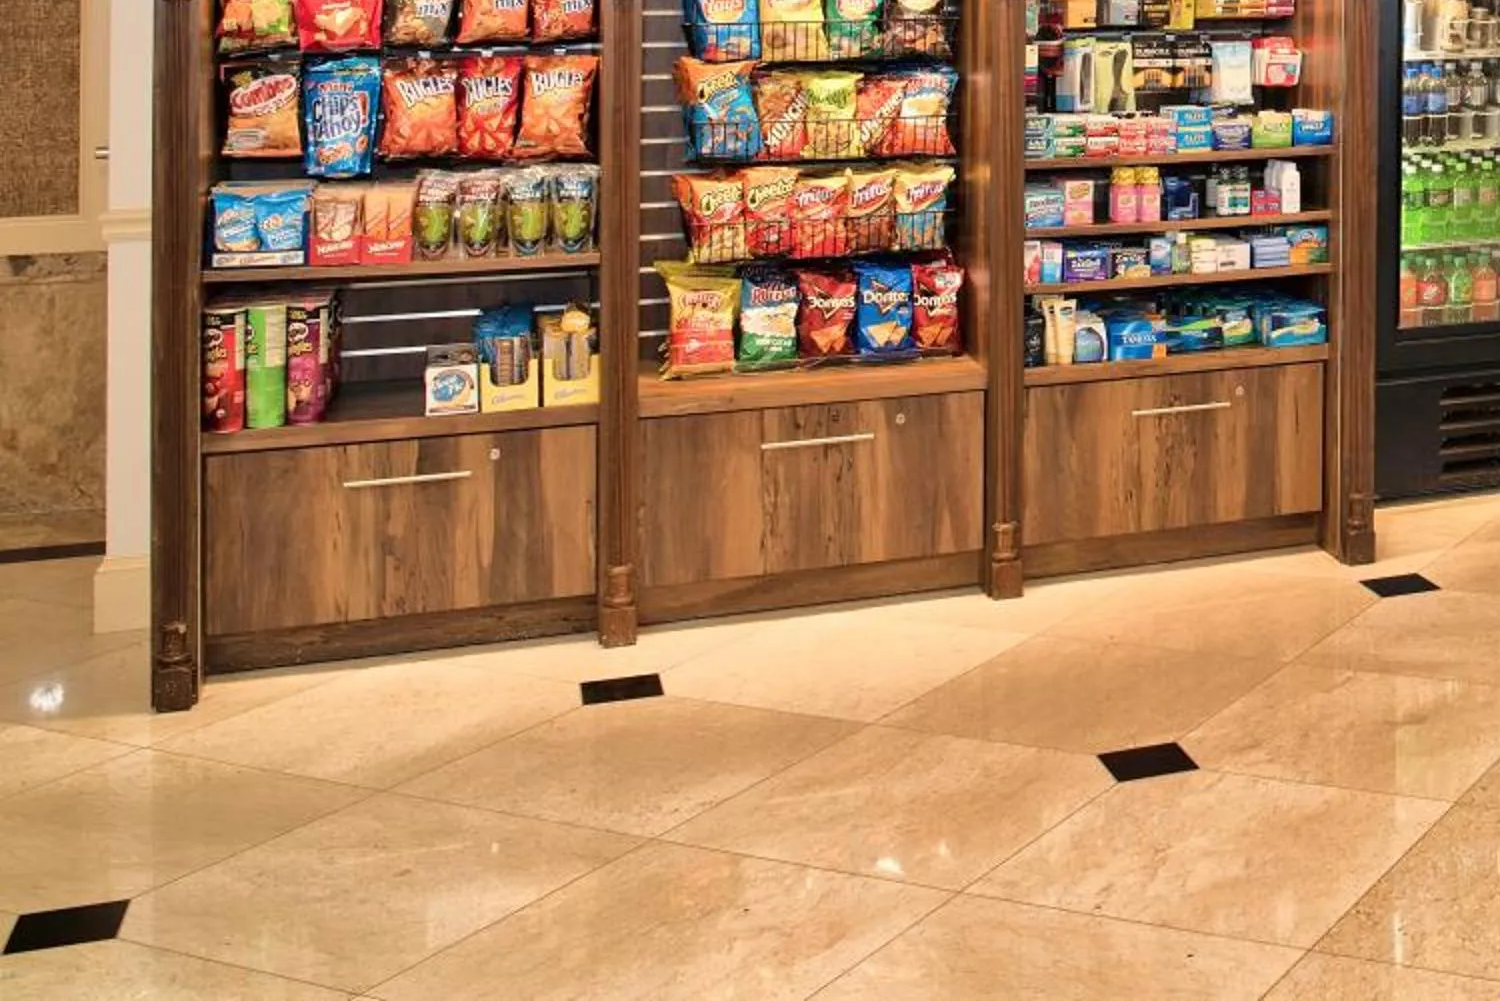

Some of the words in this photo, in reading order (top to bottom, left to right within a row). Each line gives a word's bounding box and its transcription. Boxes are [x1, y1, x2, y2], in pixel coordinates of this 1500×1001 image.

[313, 94, 361, 122] Chips
[395, 75, 455, 109] BUGLES
[701, 184, 744, 216] Cheeto
